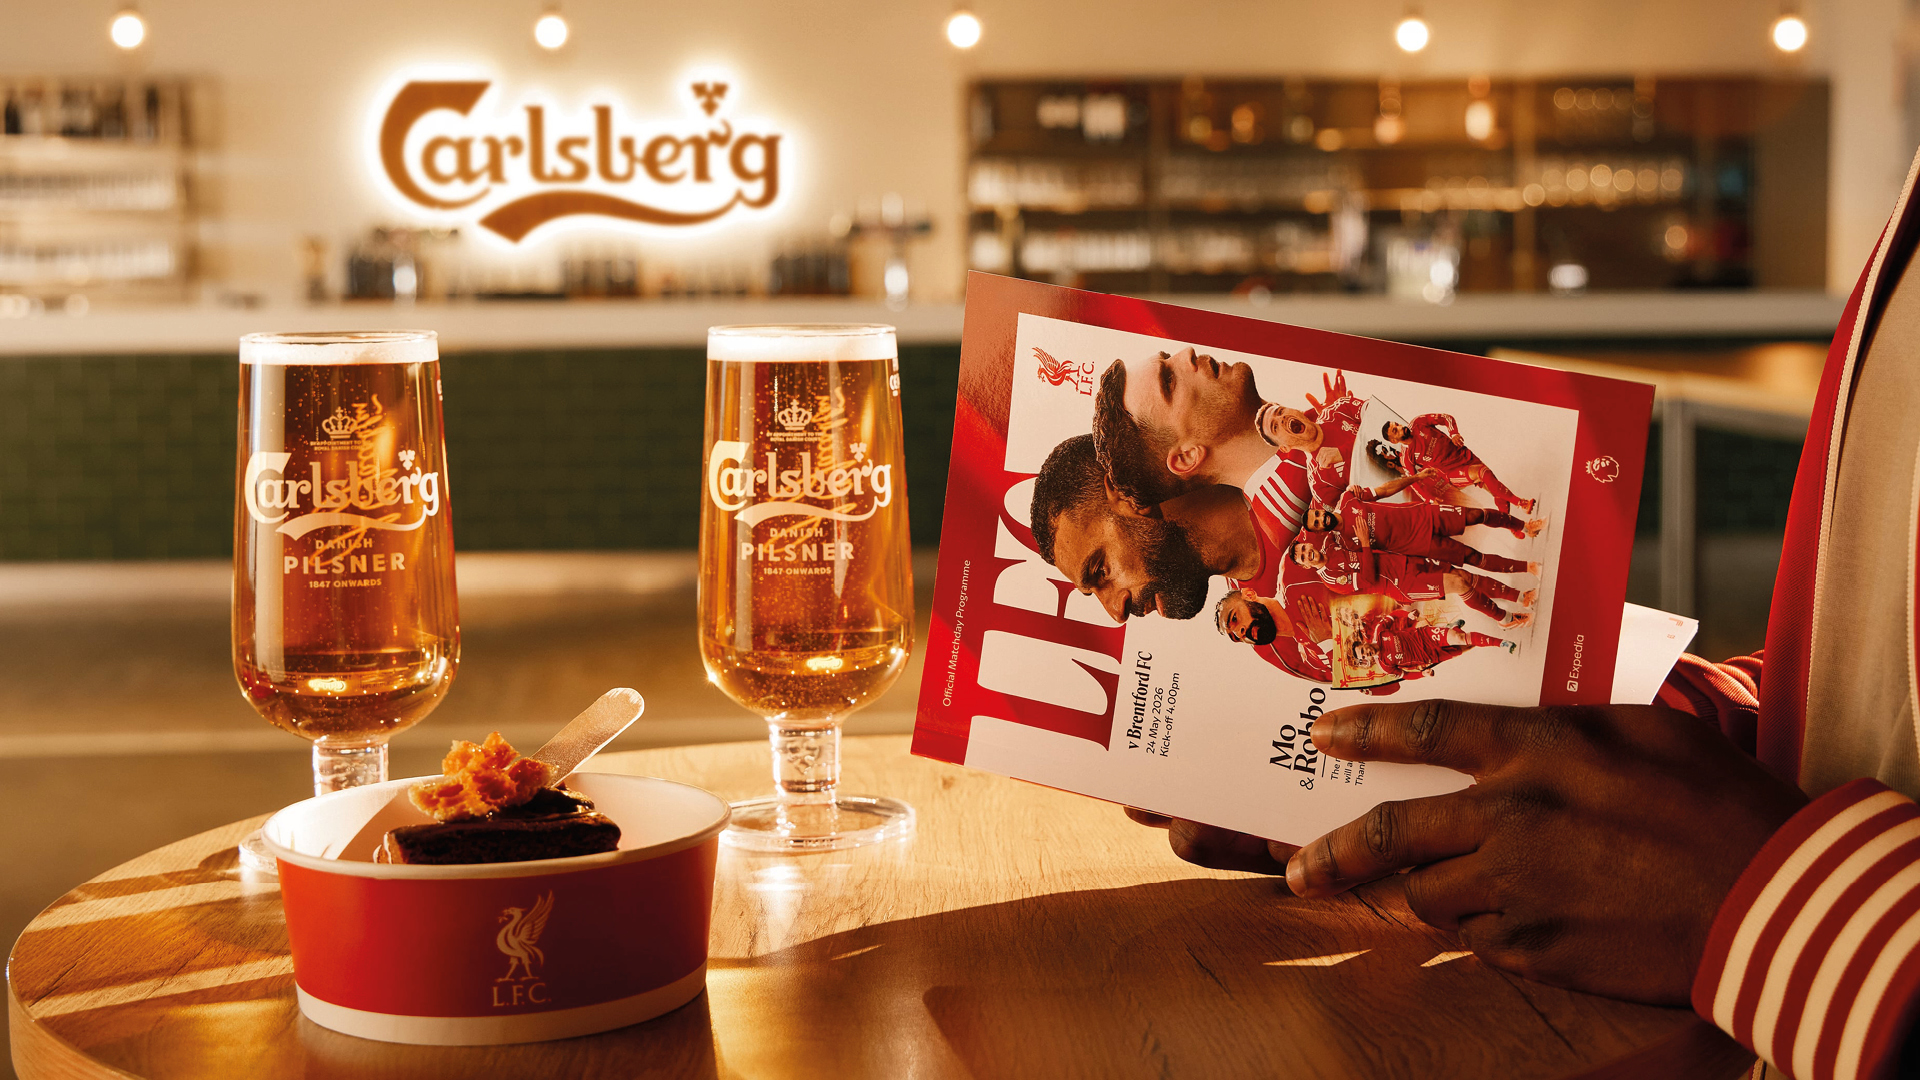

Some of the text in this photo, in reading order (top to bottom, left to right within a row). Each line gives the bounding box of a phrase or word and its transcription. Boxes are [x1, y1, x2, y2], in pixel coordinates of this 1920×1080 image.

[379, 80, 782, 210] Carlsberg
[1079, 361, 1095, 397] L.F.C.
[244, 451, 440, 524] Carlsberg
[708, 440, 892, 512] Carlsberg
[315, 538, 373, 549] DANISH
[770, 527, 824, 538] DANISH
[283, 553, 406, 575] PILSNER
[741, 541, 854, 562] PILSNER
[309, 578, 382, 589] 1847 ONWARDS
[763, 566, 832, 576] 1847 ONWARDS
[942, 559, 971, 707] Official Matchday Programme
[1431, 627, 1441, 641] 26
[1568, 634, 1585, 679] Expedia
[1126, 650, 1153, 750] v Brentford FC
[1146, 686, 1164, 755] 24 May 2026
[1159, 672, 1180, 758] Kick-off 4.00pm
[1269, 724, 1297, 771] Mo
[1299, 777, 1315, 791] &
[1330, 763, 1341, 781] The
[1344, 768, 1352, 784] will
[492, 982, 552, 1007] L.F.C.
